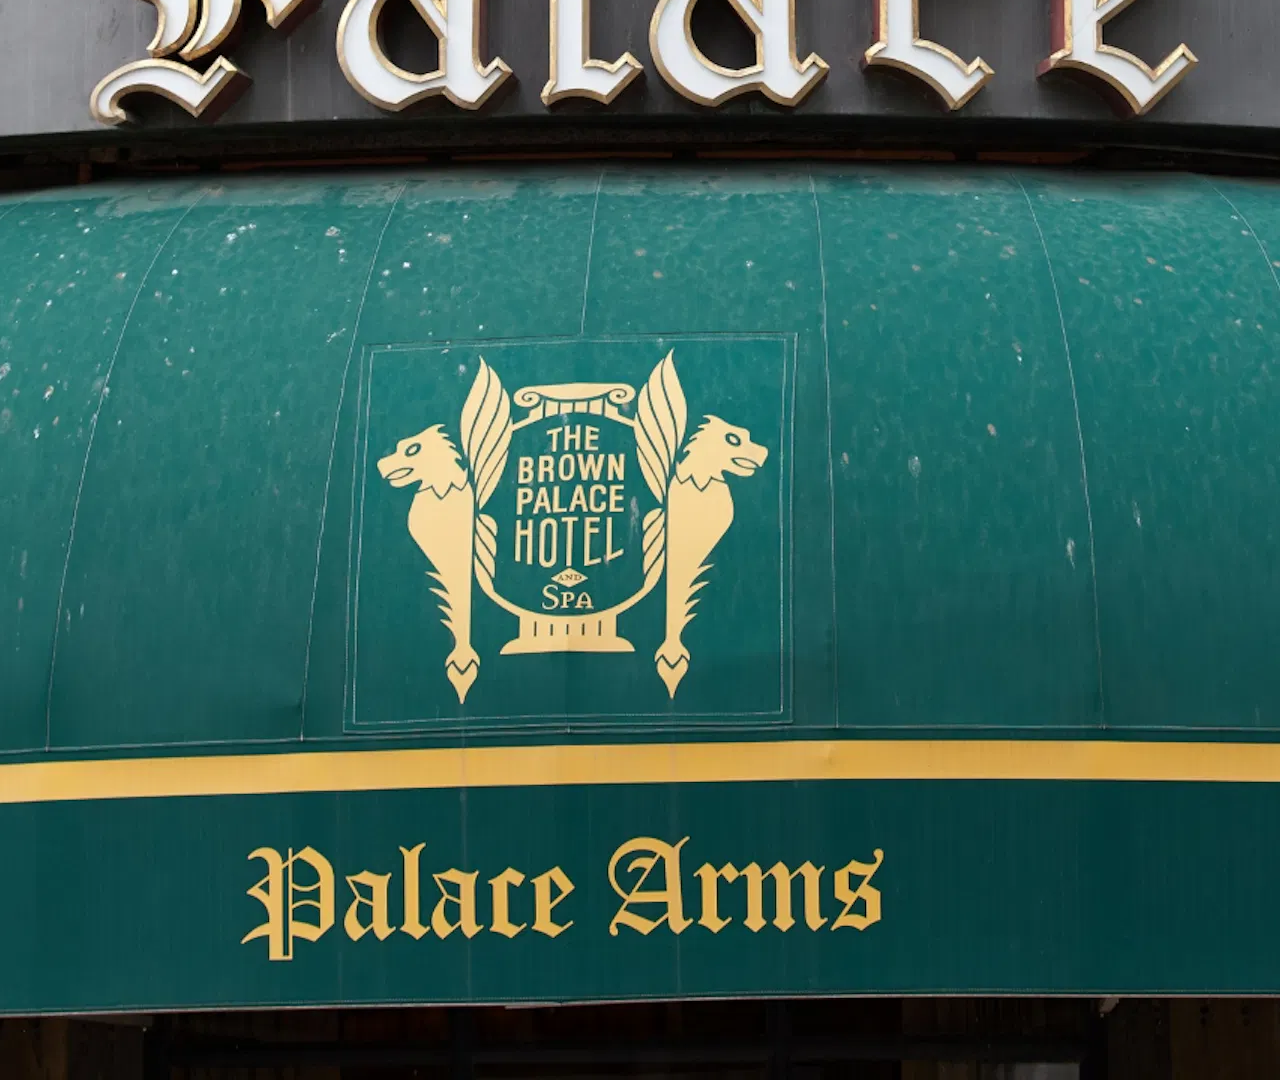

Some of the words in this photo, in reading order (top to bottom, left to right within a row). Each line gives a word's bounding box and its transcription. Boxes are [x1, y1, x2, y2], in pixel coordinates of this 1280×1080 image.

[546, 424, 599, 451] THE
[517, 453, 625, 484] BROWN
[516, 484, 625, 516] PALACE
[514, 516, 625, 568] HOTEL
[240, 841, 575, 961] Palace
[607, 835, 884, 937] Arms
